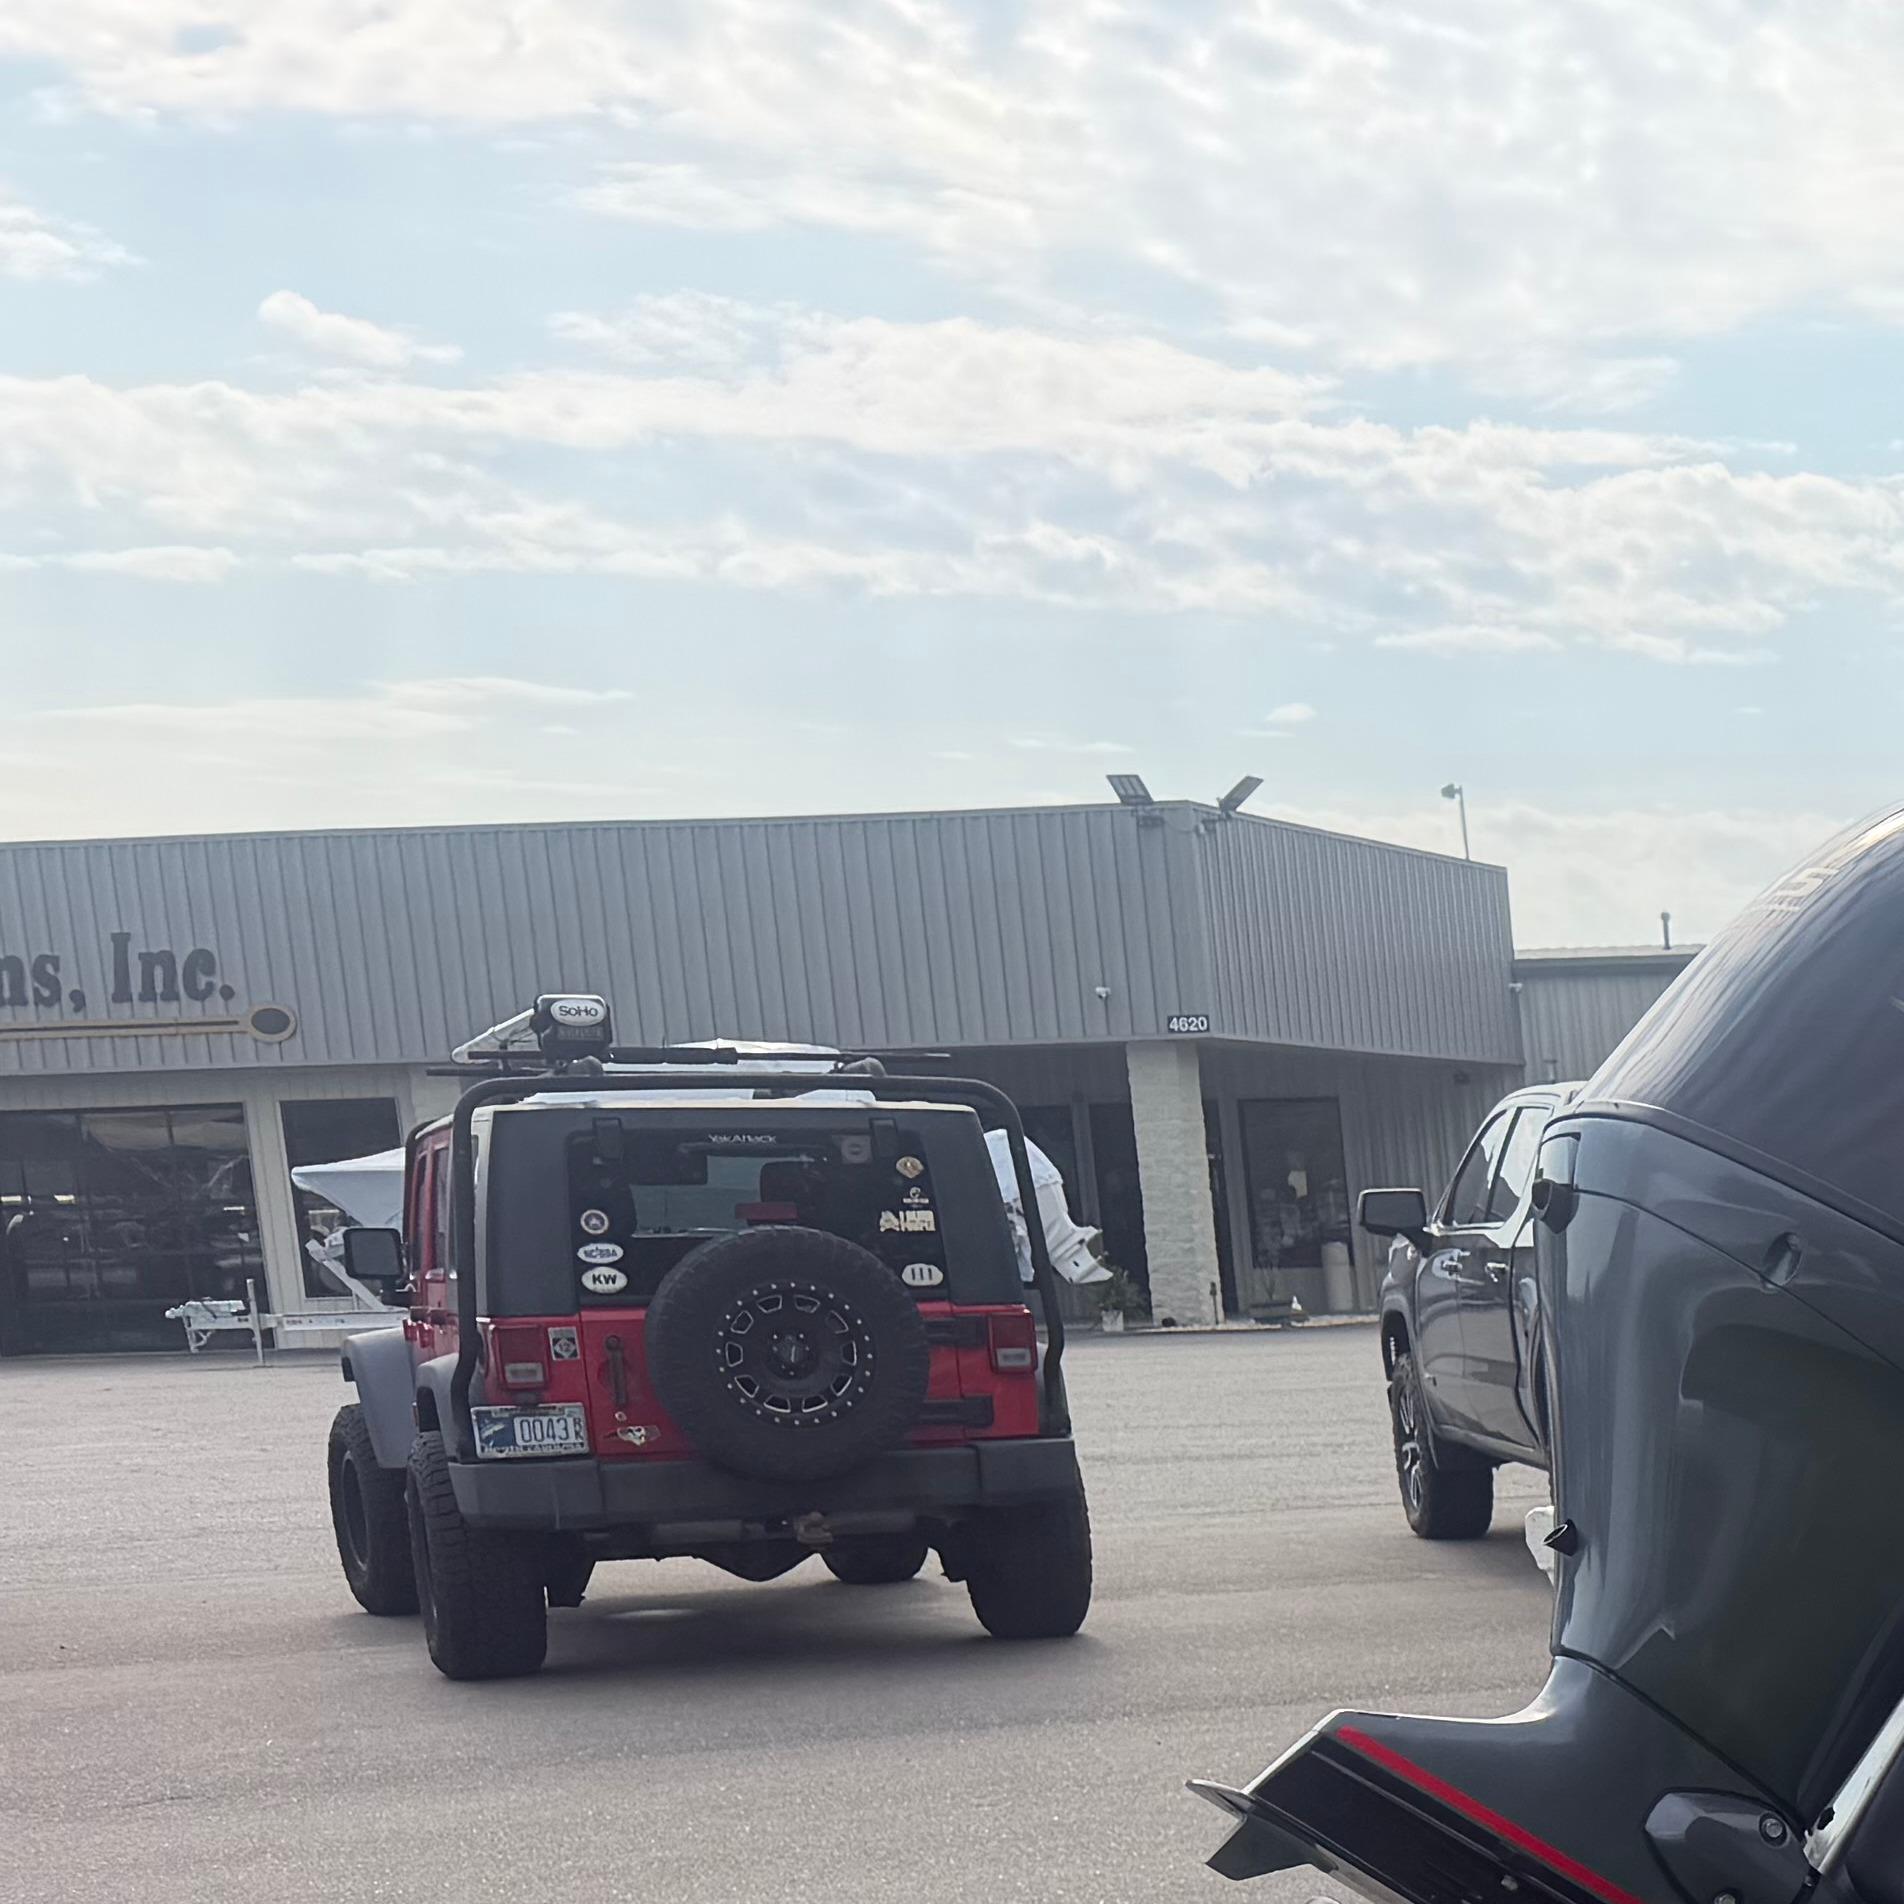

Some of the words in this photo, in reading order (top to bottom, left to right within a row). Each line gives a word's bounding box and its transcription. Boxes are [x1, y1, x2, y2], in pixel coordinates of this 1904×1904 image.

[110, 932, 236, 1004] Inc.
[1169, 1016, 1208, 1032] 4620
[592, 1273, 617, 1285] KW
[519, 1417, 570, 1443] 0043
